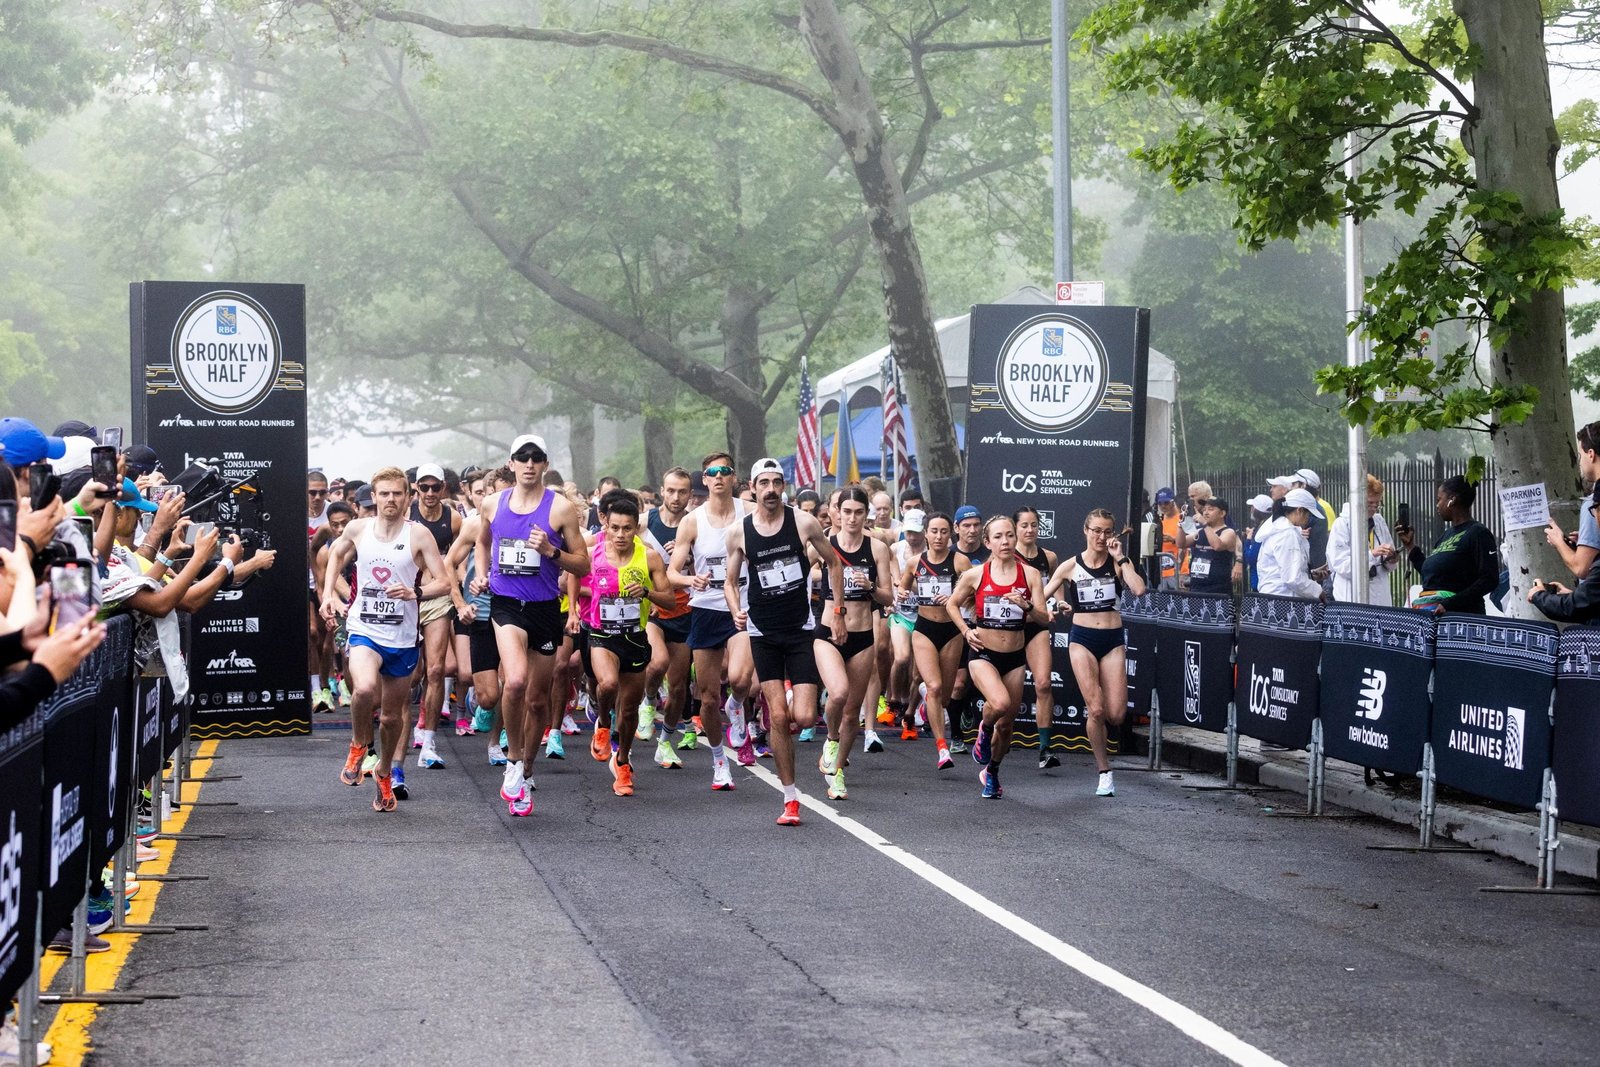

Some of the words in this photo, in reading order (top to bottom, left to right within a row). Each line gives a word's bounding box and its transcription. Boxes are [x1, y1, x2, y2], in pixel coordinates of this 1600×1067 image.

[218, 326, 235, 334] RBC
[186, 342, 268, 362] BROOKLYN
[1044, 347, 1062, 355] RBC
[208, 364, 246, 382] HALF
[1010, 363, 1094, 383] BROOKLYN
[1030, 384, 1071, 402] HALF
[1083, 440, 1119, 448] RUNNERS
[223, 469, 257, 477] SERVICES
[1041, 470, 1063, 478] TATA
[1002, 468, 1037, 493] tcs
[1040, 478, 1092, 487] CONSULTANCY
[1040, 487, 1073, 495] SERVICES
[1511, 488, 1541, 500] PARKING
[516, 552, 526, 563] 15
[781, 570, 787, 582] 1
[931, 586, 940, 595] 42
[1094, 588, 1104, 599] 25
[373, 601, 395, 613] 4973
[619, 608, 625, 618] 4
[1000, 607, 1011, 618] 26
[1272, 667, 1284, 682] TATA
[1250, 663, 1270, 716] tcs
[1270, 686, 1299, 704] CONSULTANCY
[1186, 697, 1197, 714] RBC
[1269, 704, 1287, 721] SERVICES
[1461, 704, 1504, 731] UNITED
[1348, 726, 1362, 742] new
[1362, 725, 1388, 750] balance
[1448, 729, 1502, 760] AIRLINES
